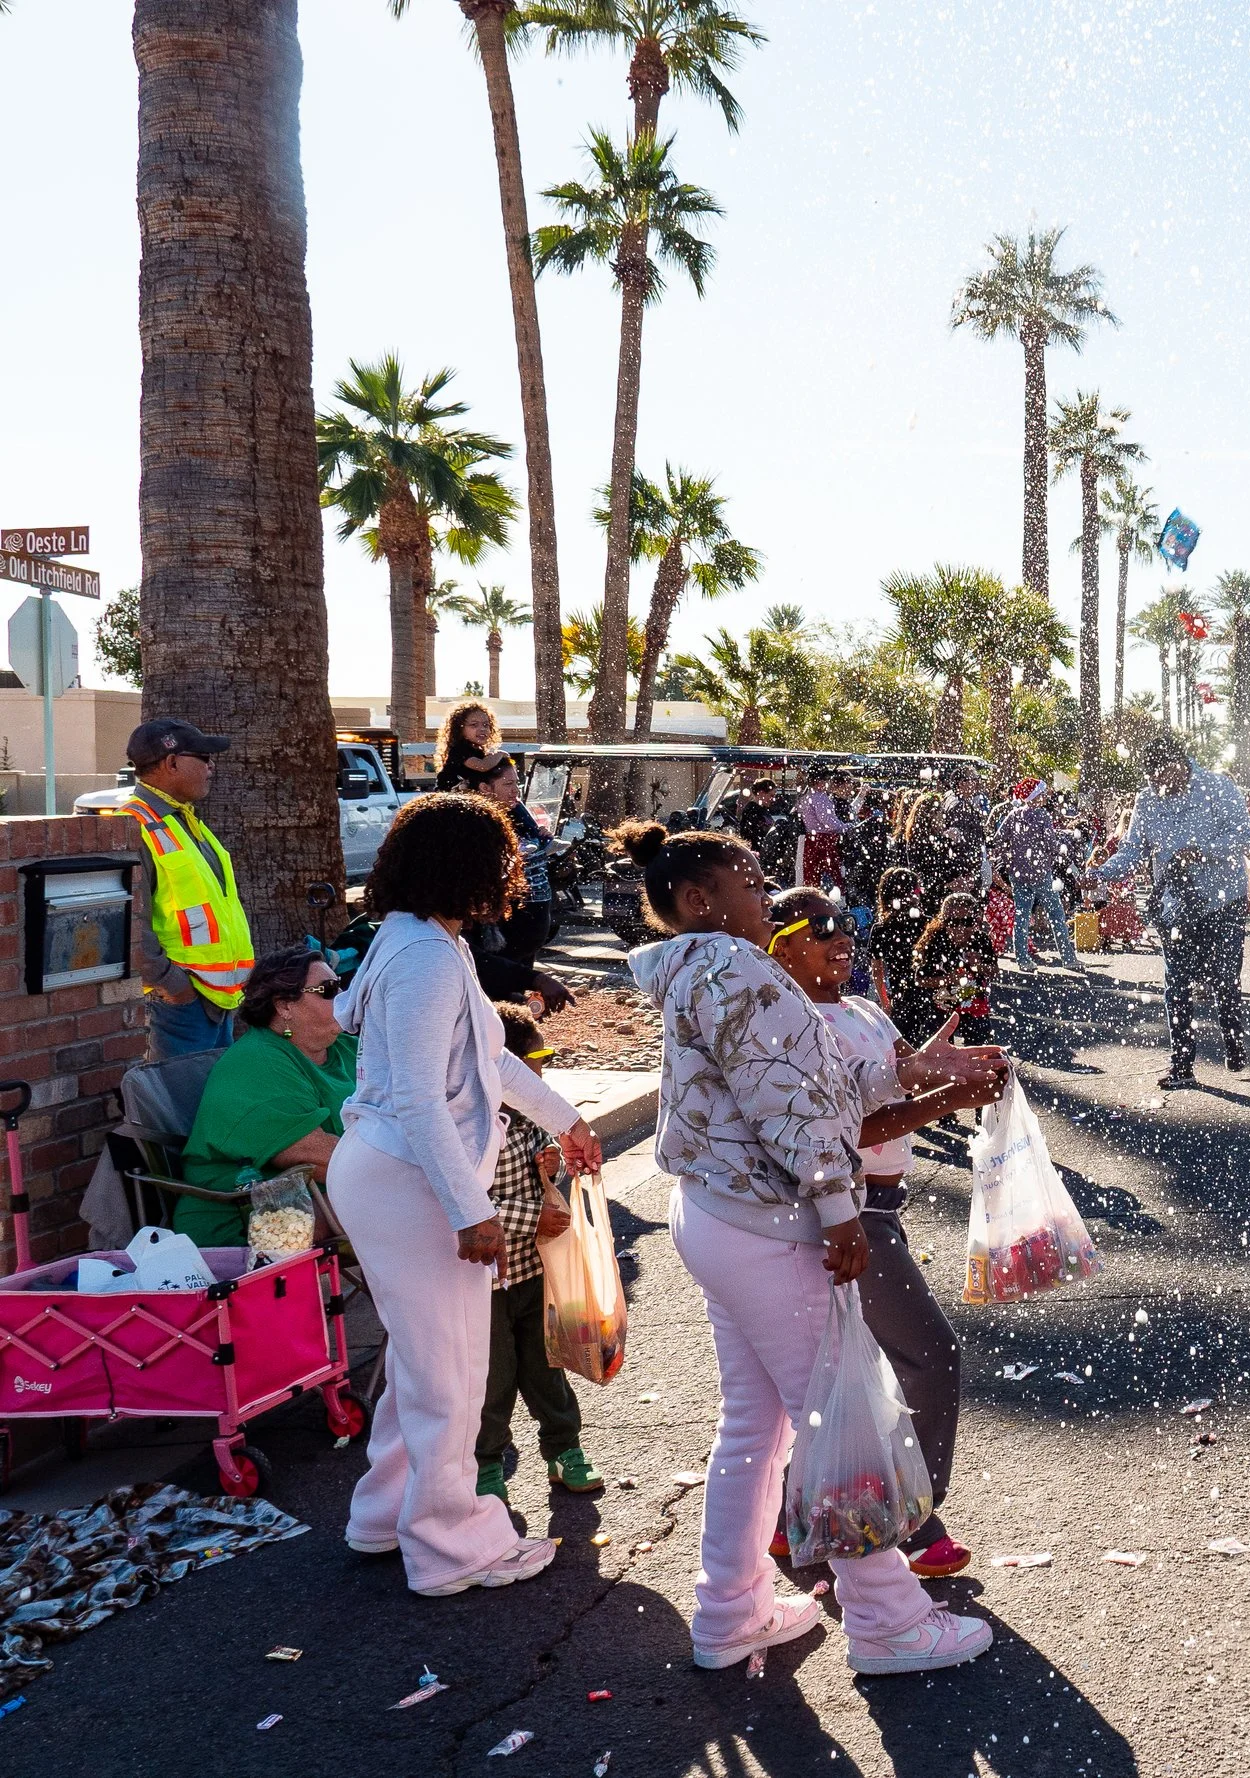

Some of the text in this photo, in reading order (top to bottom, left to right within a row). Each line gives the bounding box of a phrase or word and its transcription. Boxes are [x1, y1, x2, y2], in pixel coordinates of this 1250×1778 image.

[26, 530, 87, 553] Oeste Ln
[9, 556, 98, 596] Old Litchfield Rd
